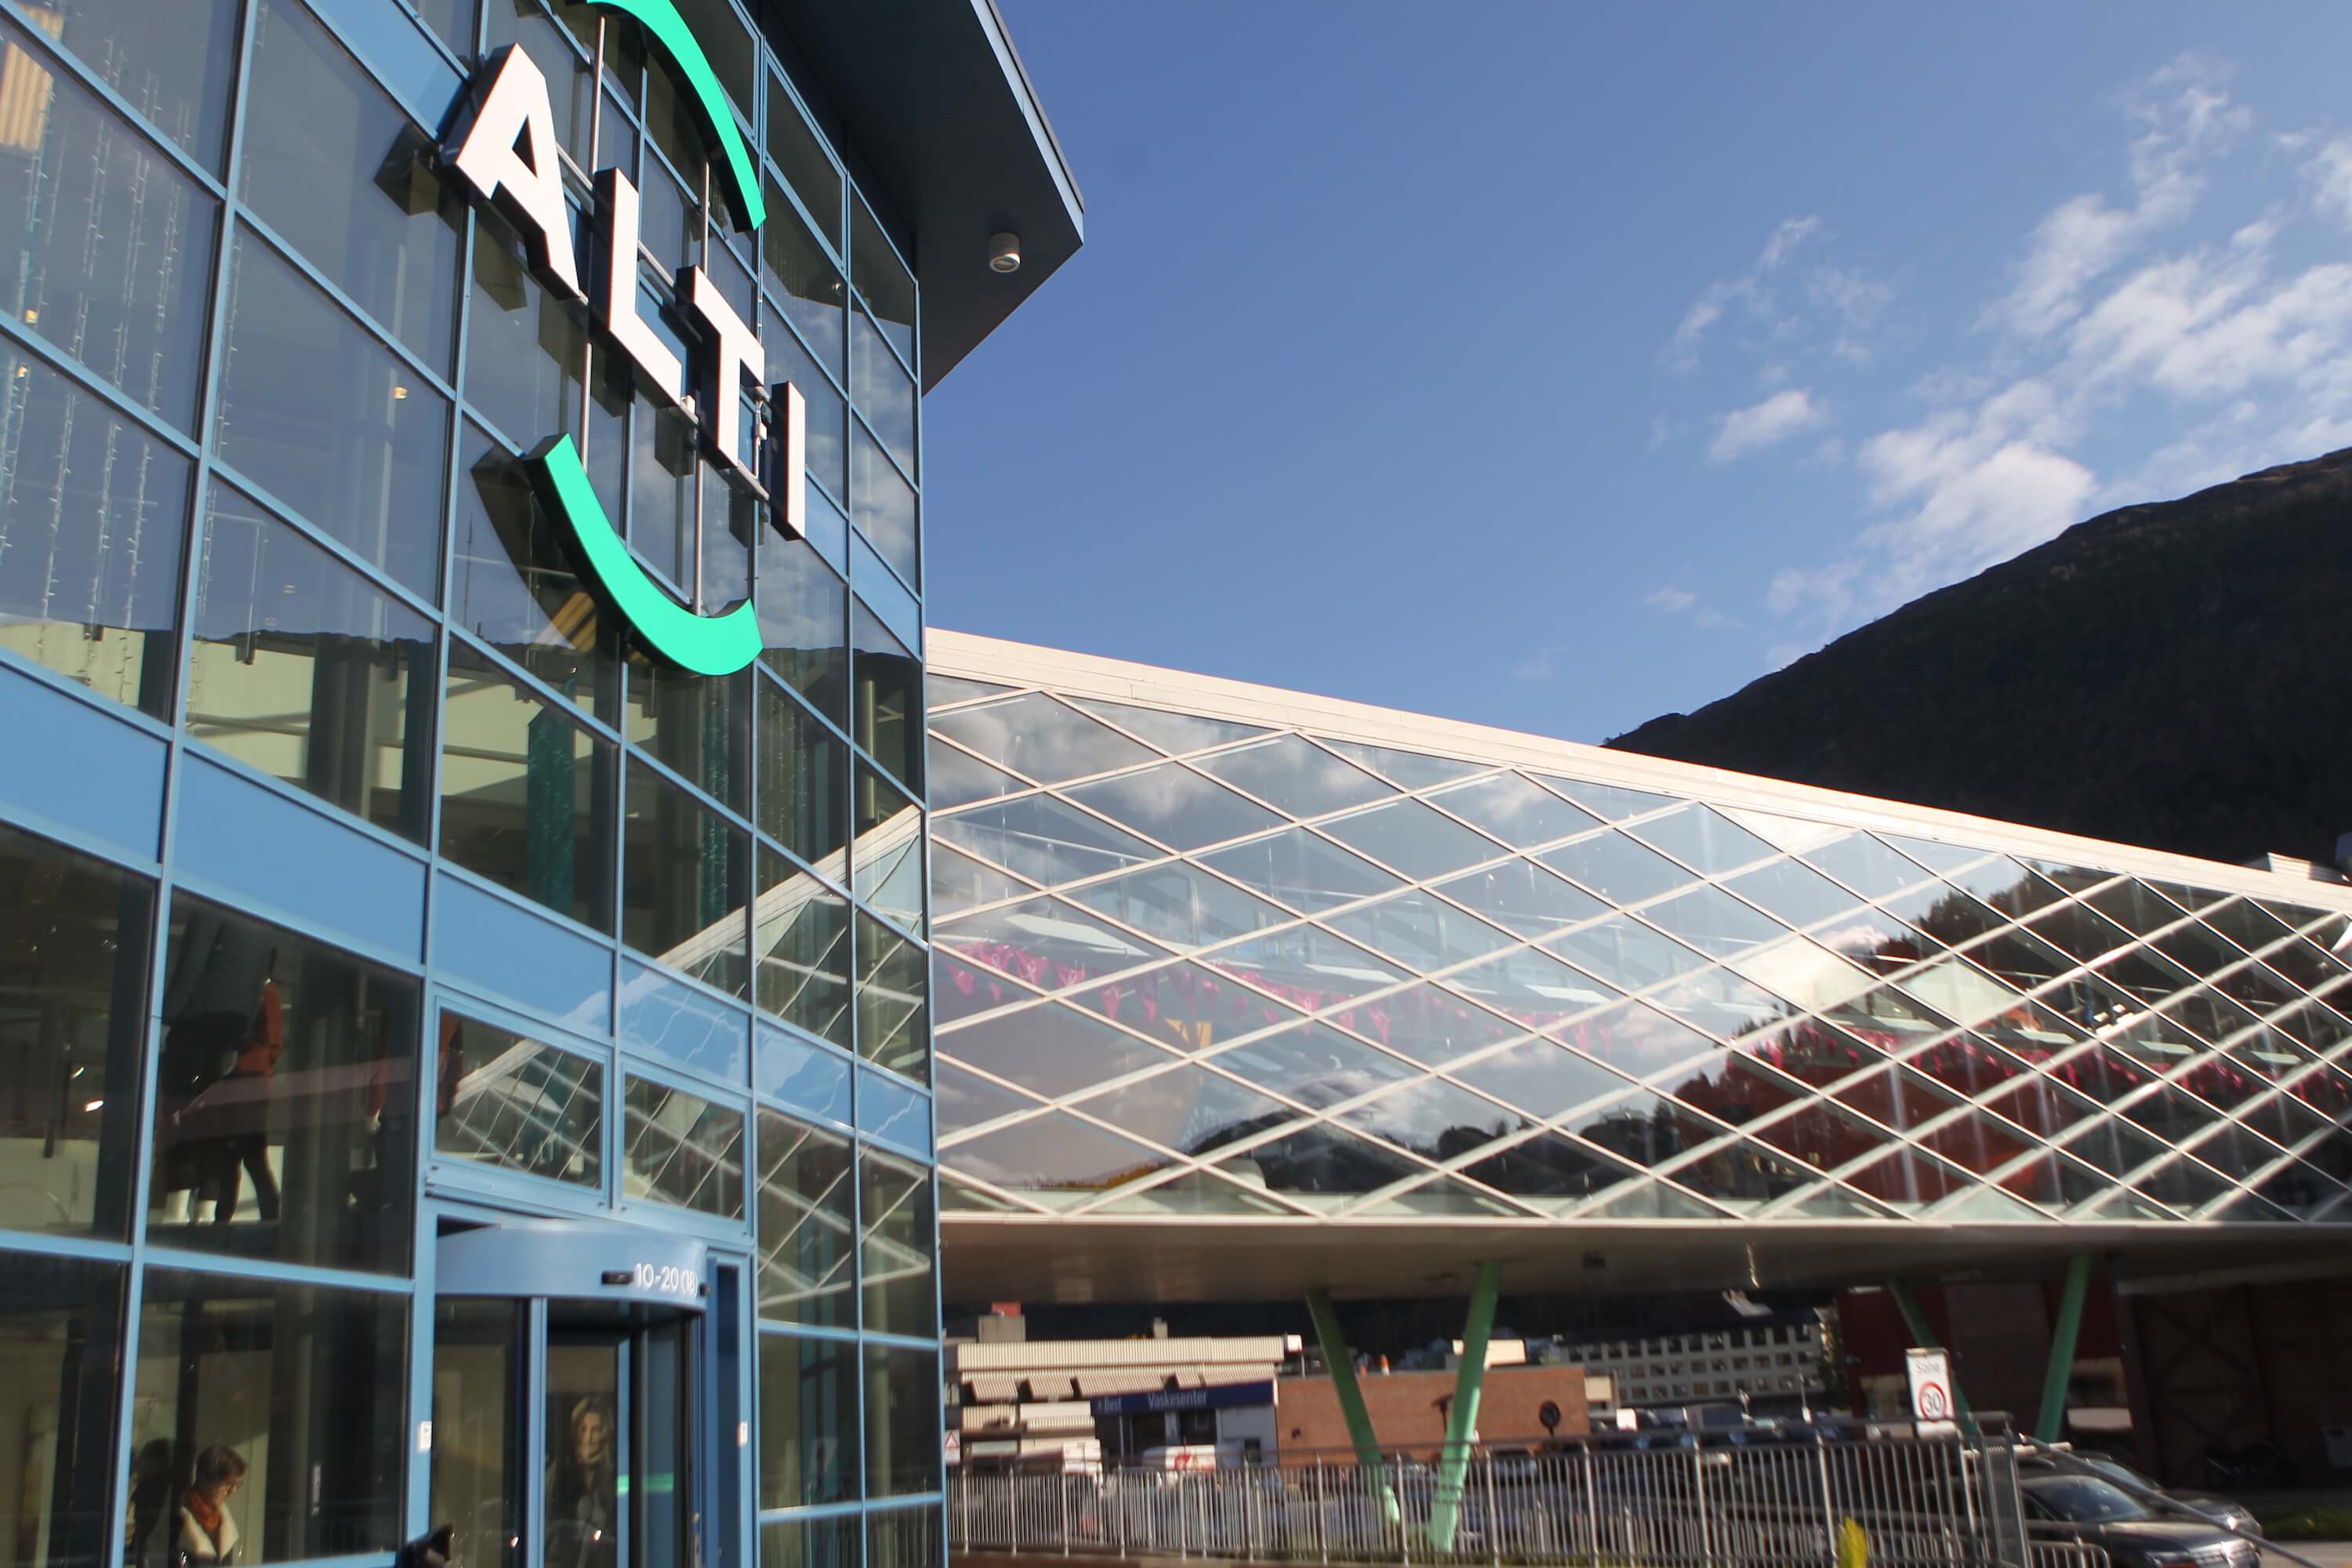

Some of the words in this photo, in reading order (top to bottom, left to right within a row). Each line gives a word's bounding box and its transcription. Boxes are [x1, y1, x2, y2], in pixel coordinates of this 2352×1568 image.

[455, 42, 806, 541] ALTI
[634, 1262, 679, 1293] 10-20
[681, 1267, 698, 1298] (18)
[1148, 1390, 1207, 1409] Vaskesenter
[1924, 1392, 1942, 1413] 30
